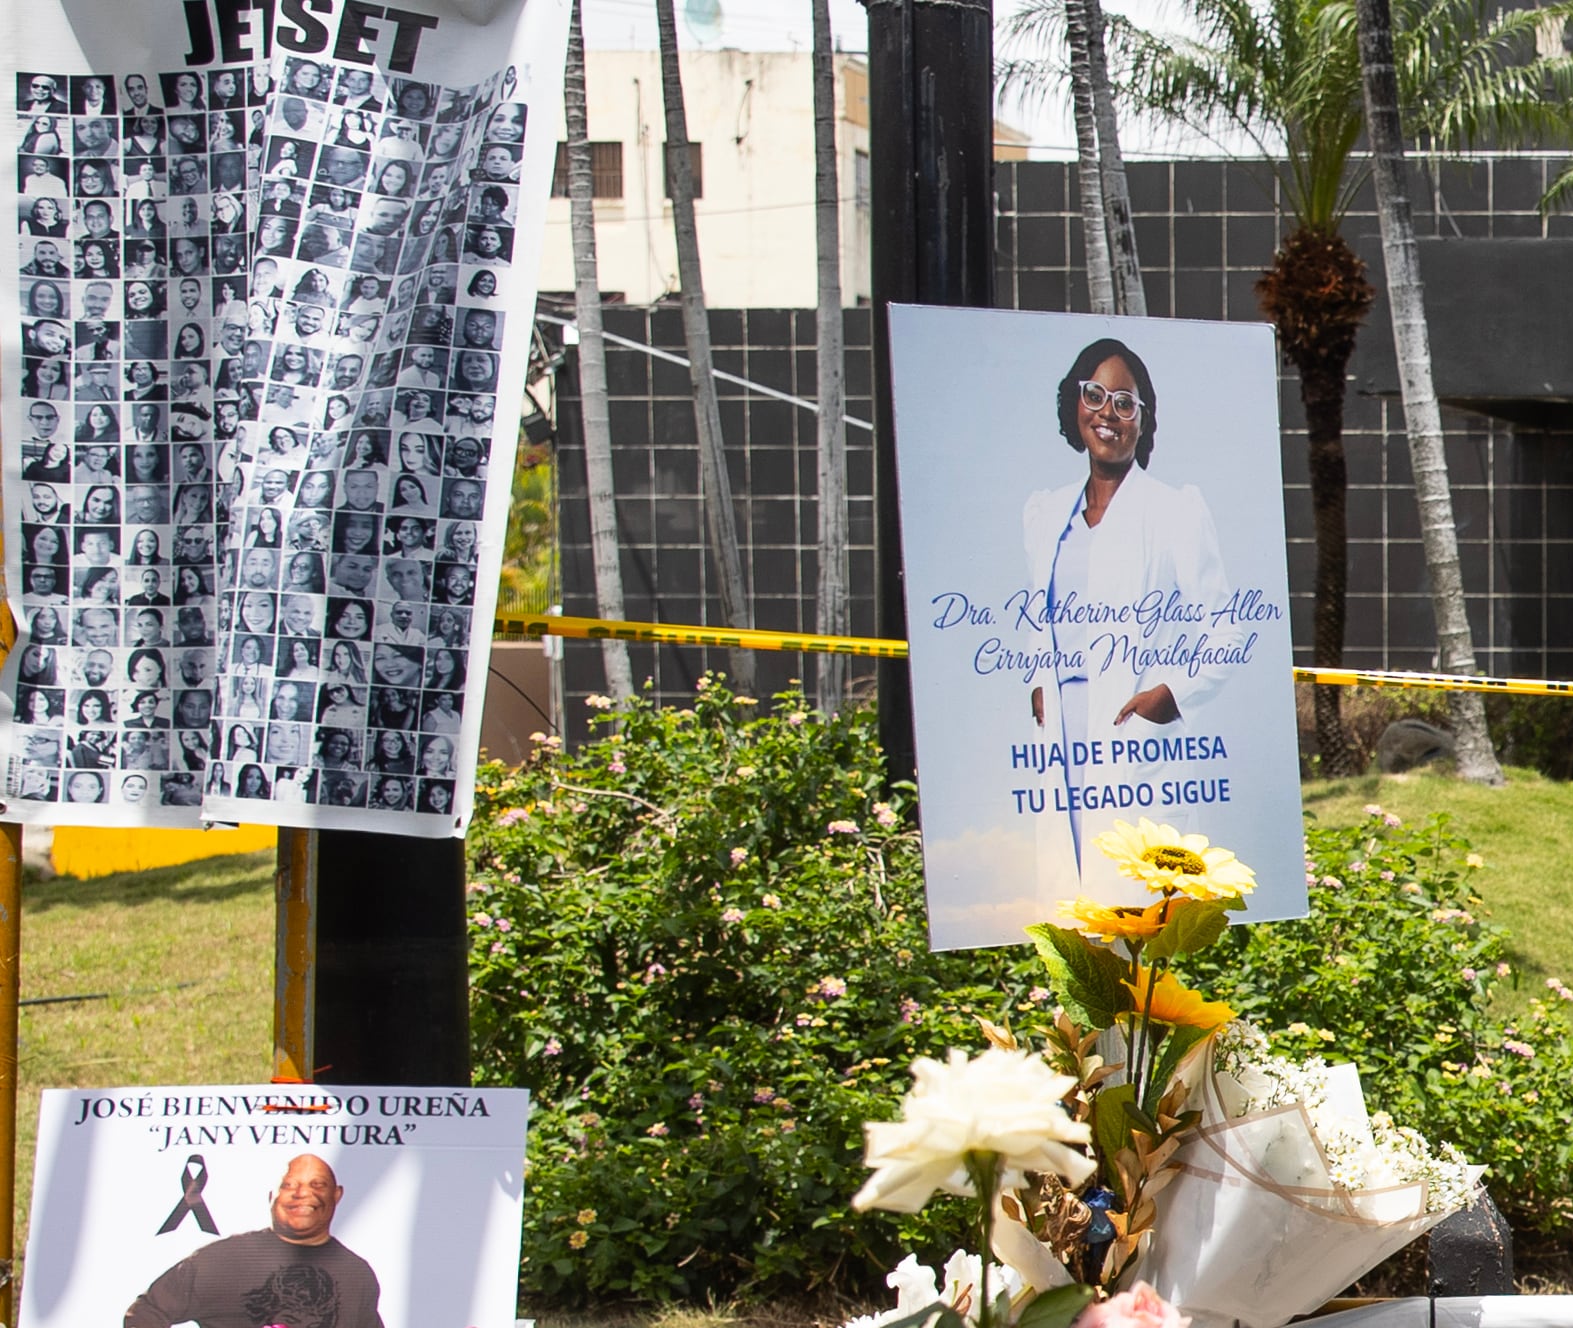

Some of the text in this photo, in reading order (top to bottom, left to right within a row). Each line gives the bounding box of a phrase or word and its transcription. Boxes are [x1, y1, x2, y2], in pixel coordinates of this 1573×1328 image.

[931, 589, 1282, 637] Dra. Katherine Glass Allen
[1089, 632, 1258, 678] Maxilofacial
[1011, 736, 1227, 773] HIJA DE PROMESA
[1012, 779, 1231, 814] TU LEGADO SIGUE
[74, 1091, 490, 1126] JOSÉ BIENVENIDO UREÑA
